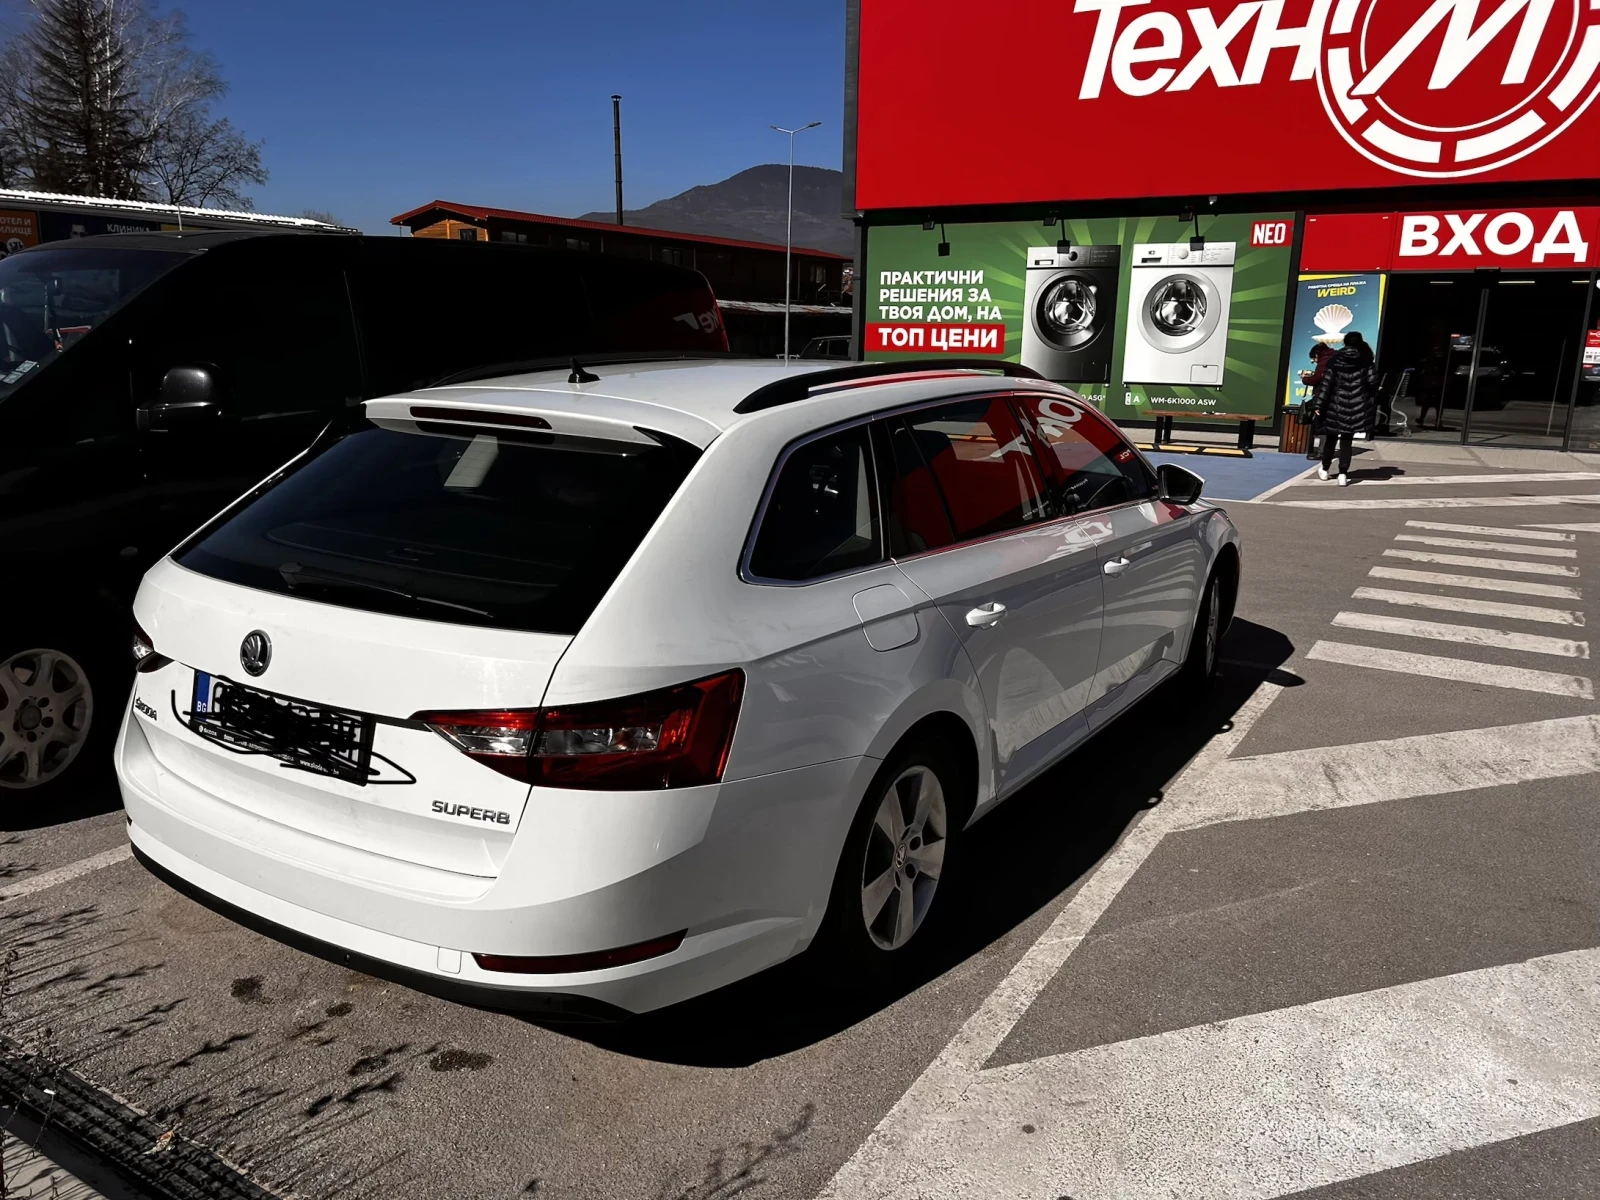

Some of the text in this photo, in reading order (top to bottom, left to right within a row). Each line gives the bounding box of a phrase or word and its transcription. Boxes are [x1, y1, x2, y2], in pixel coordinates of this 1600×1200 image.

[23, 217, 31, 226] И
[1253, 223, 1286, 244] NEO
[1398, 210, 1589, 263] ВХОД
[880, 269, 984, 286] ПРАКТИЧНИ
[879, 287, 992, 303] РЕШЕНИЯ ЗА
[1318, 287, 1356, 297] WEIRD
[879, 305, 1002, 323] ТВОЯ ДОМ, НА
[879, 327, 998, 351] ТОП ЦЕНИ
[1132, 395, 1141, 403] A
[1150, 397, 1217, 406] WM-6K1000 ASW
[197, 701, 207, 713] BG
[432, 799, 510, 825] SUPERB
